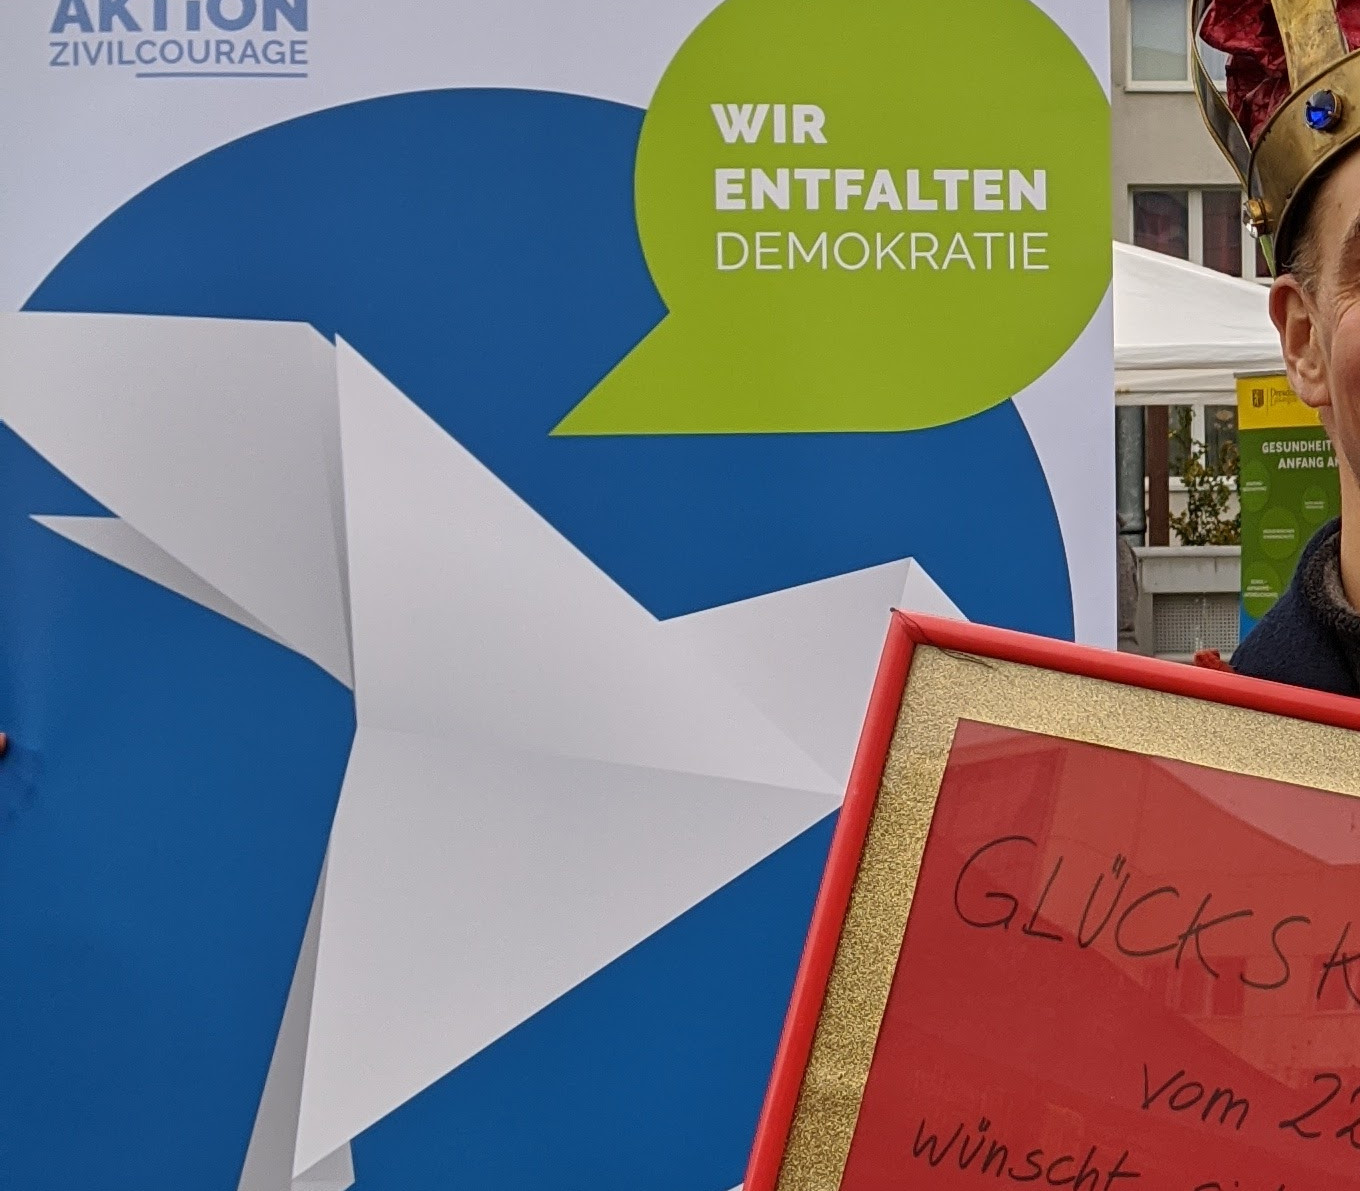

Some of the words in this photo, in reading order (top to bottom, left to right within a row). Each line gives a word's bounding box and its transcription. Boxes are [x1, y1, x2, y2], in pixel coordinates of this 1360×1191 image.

[49, 39, 308, 67] ZIVILCOURAGE
[711, 104, 827, 144] WIR
[715, 168, 1048, 211] ENTFALTEN
[716, 231, 1050, 270] DEMOKRATIE
[1262, 440, 1331, 453] GESUNDHEIT
[1278, 457, 1324, 469] ANFANG
